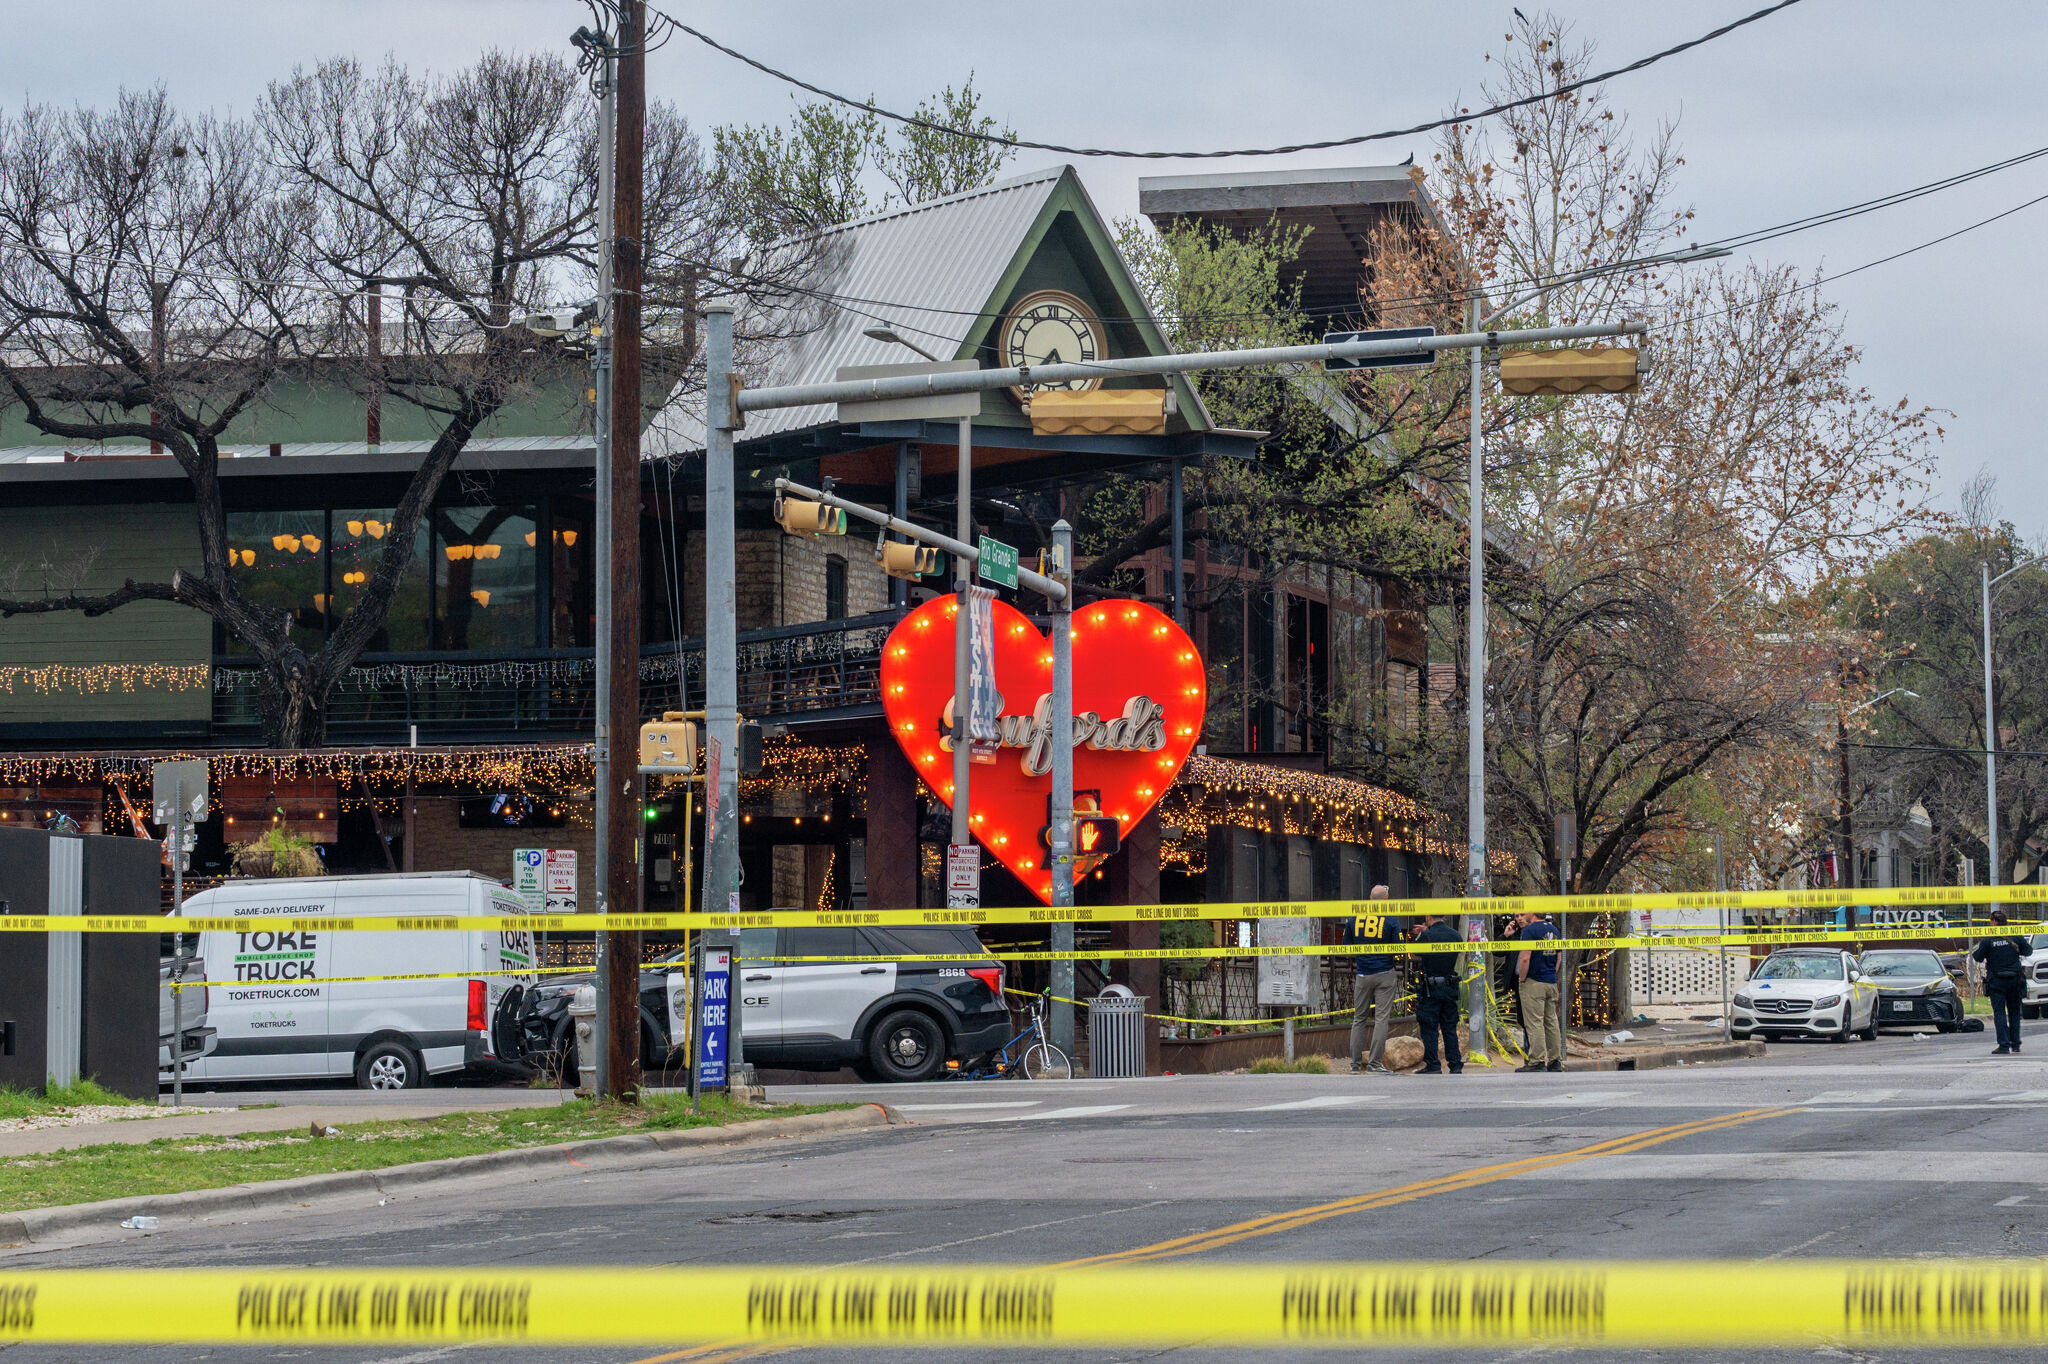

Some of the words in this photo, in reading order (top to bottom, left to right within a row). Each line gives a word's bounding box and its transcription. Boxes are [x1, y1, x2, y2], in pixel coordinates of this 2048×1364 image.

[981, 539, 990, 561] Rio
[992, 543, 1011, 568] Grande
[547, 852, 556, 860] NO
[950, 847, 958, 856] NO
[234, 907, 281, 916] SAME-DAY
[283, 905, 325, 914] DELIVERY
[1136, 908, 1151, 918] POLICE
[1154, 908, 1163, 918] LINE
[1165, 908, 1171, 917] DO
[1173, 908, 1181, 917] NOT
[1183, 908, 1198, 917] CROSS
[1243, 906, 1258, 916] POLICE
[1261, 906, 1270, 916] LINE
[1272, 906, 1278, 915] DO
[1280, 906, 1288, 915] NOT
[1291, 905, 1306, 915] CROSS
[1352, 904, 1367, 913] POLICE
[1369, 904, 1379, 913] LINE
[1381, 904, 1387, 913] DO
[1389, 904, 1397, 913] NOT
[1400, 903, 1415, 912] CROSS
[816, 914, 832, 924] POLICE
[834, 914, 843, 924] LINE
[845, 914, 851, 923] DO
[853, 914, 861, 923] NOT
[864, 914, 879, 923] CROSS
[924, 912, 939, 922] POLICE
[941, 912, 950, 922] LINE
[952, 912, 958, 921] DO
[960, 912, 968, 921] NOT
[971, 912, 986, 921] CROSS
[1030, 910, 1045, 920] POLICE
[1047, 910, 1056, 920] LINE
[1058, 910, 1064, 920] DO
[1066, 910, 1074, 919] NOT
[1077, 910, 1092, 919] CROSS
[1873, 908, 1944, 928] rivers
[710, 916, 726, 926] POLICE
[728, 916, 737, 926] LINE
[739, 916, 745, 925] DO
[747, 916, 755, 925] NOT
[757, 916, 772, 925] CROSS
[1354, 915, 1385, 939] FBI
[235, 931, 316, 953] TOKE
[500, 930, 529, 955] TOKE
[237, 953, 263, 961] MOBILE
[718, 955, 728, 964] LAZ
[234, 960, 316, 981] TRUCK
[939, 968, 965, 977] 2868
[228, 988, 320, 1000] TOKETRUCK.COM
[251, 1021, 296, 1029] TOKETRUCKS
[237, 1283, 309, 1331] POLICE
[316, 1283, 361, 1331] LINE
[371, 1283, 398, 1331] DO
[406, 1283, 448, 1331] NOT
[458, 1283, 530, 1331] CROSS
[748, 1281, 818, 1331] POLICE
[832, 1281, 875, 1331] LINE
[887, 1281, 917, 1331] DO
[926, 1281, 969, 1331] NOT
[981, 1281, 1055, 1331] CROSS
[1283, 1279, 1357, 1328] POLICE
[1371, 1279, 1417, 1328] LINE
[1430, 1279, 1461, 1328] DO
[1472, 1279, 1515, 1328] NOT
[1528, 1279, 1605, 1328] CROSS
